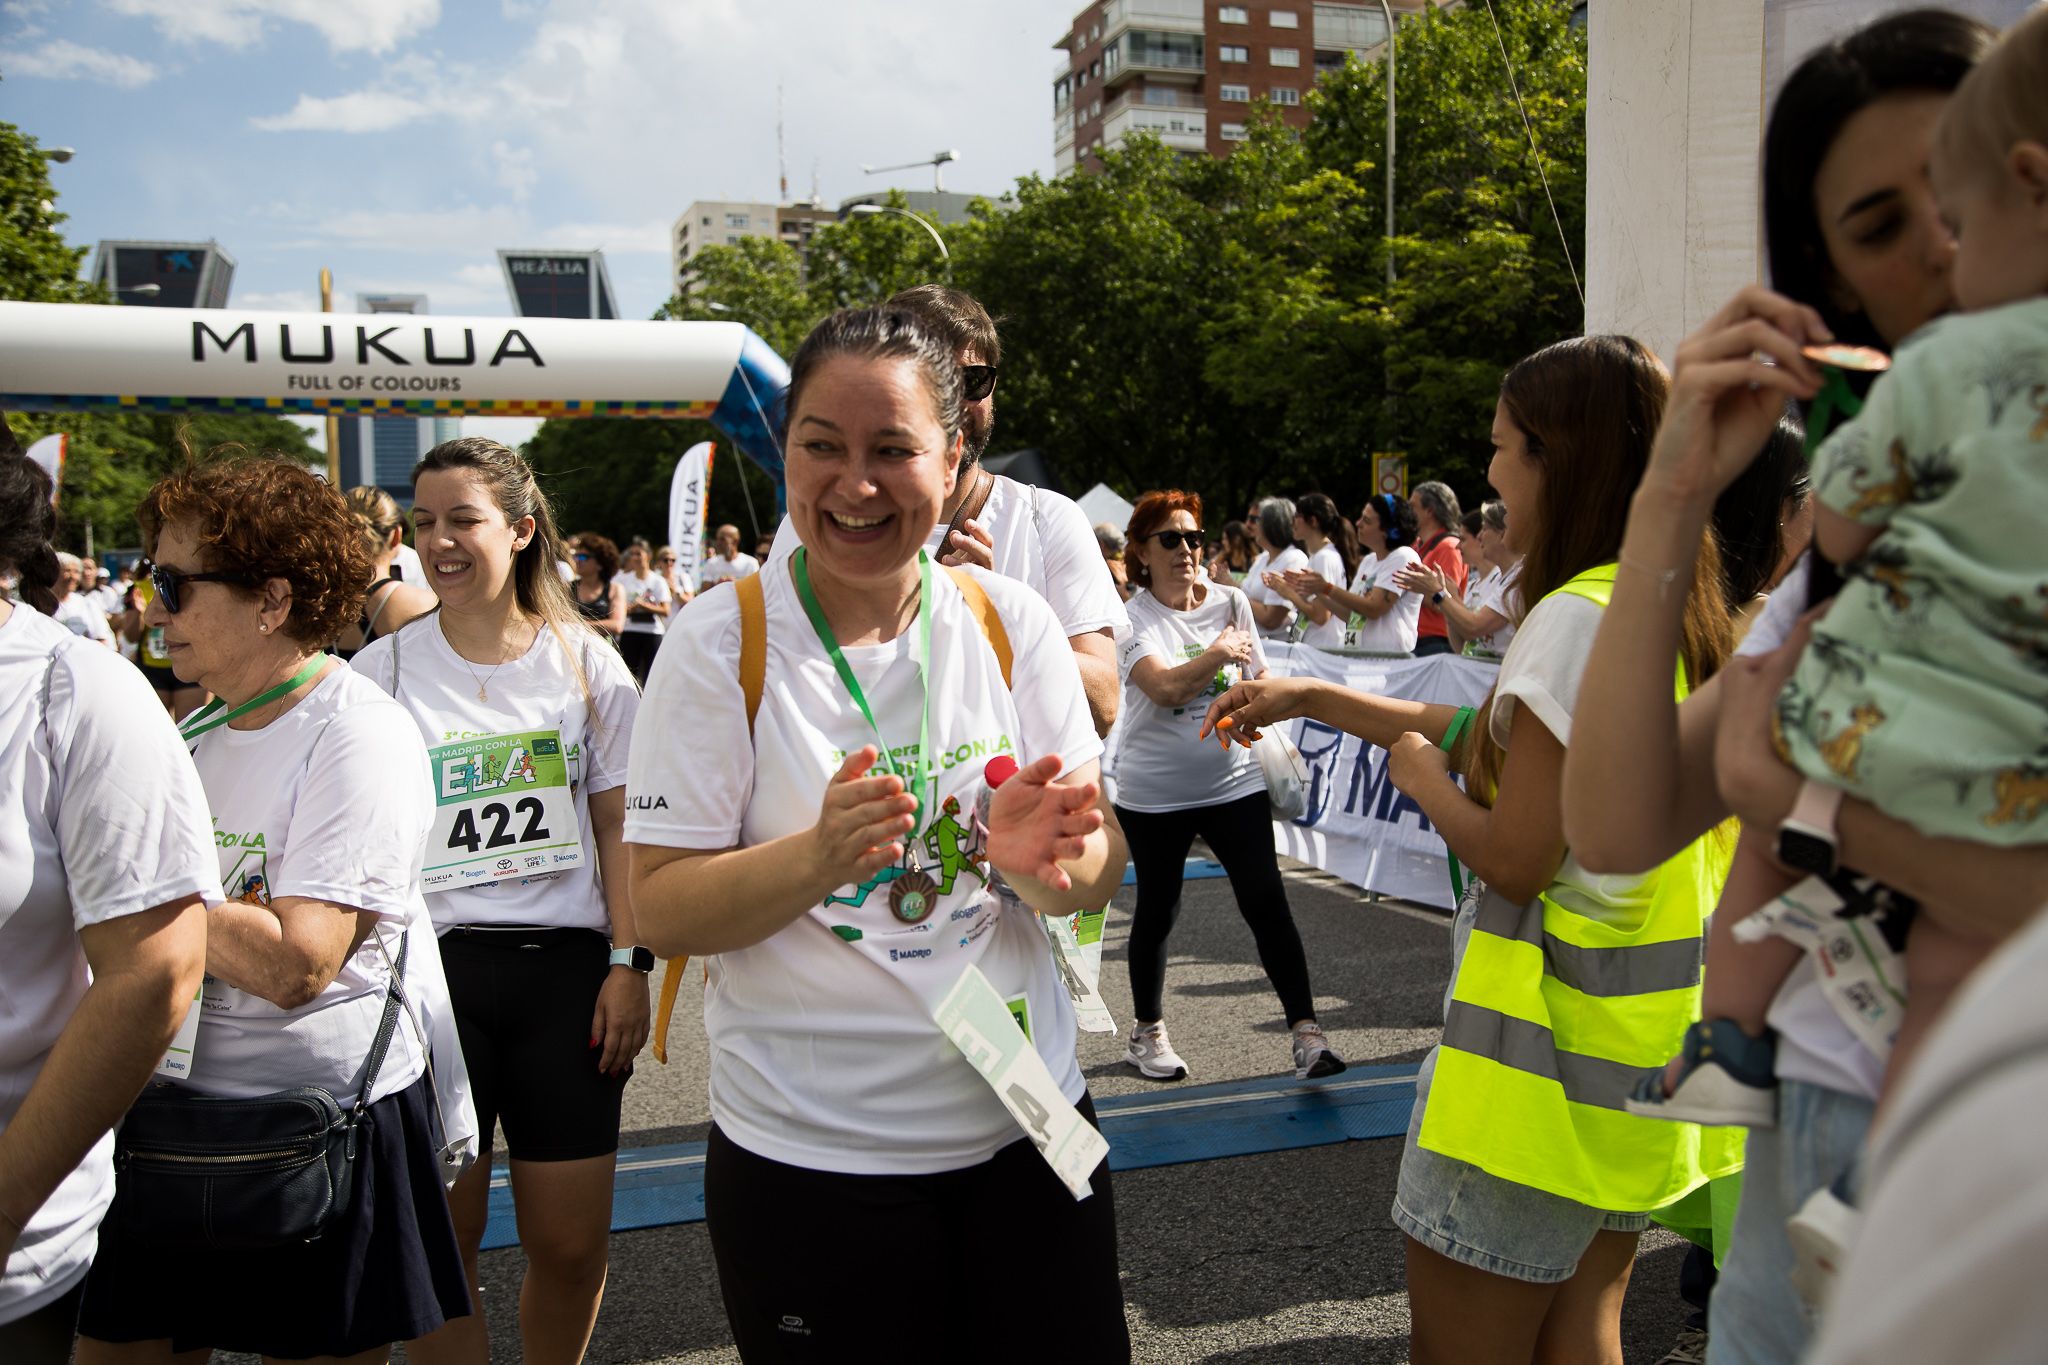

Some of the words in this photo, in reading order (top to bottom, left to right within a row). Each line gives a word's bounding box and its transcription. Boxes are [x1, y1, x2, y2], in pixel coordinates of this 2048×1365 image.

[192, 320, 546, 367] MUKUA
[287, 374, 333, 391] FULL
[338, 375, 364, 391] OF
[370, 375, 462, 392] COLOURS
[442, 744, 483, 759] MADRID
[485, 740, 507, 751] CON
[509, 738, 522, 748] LA
[940, 738, 987, 770] CON
[441, 746, 537, 799] ELA
[447, 796, 551, 853] 422
[424, 873, 453, 883] MUKUA
[899, 948, 932, 960] MADRID
